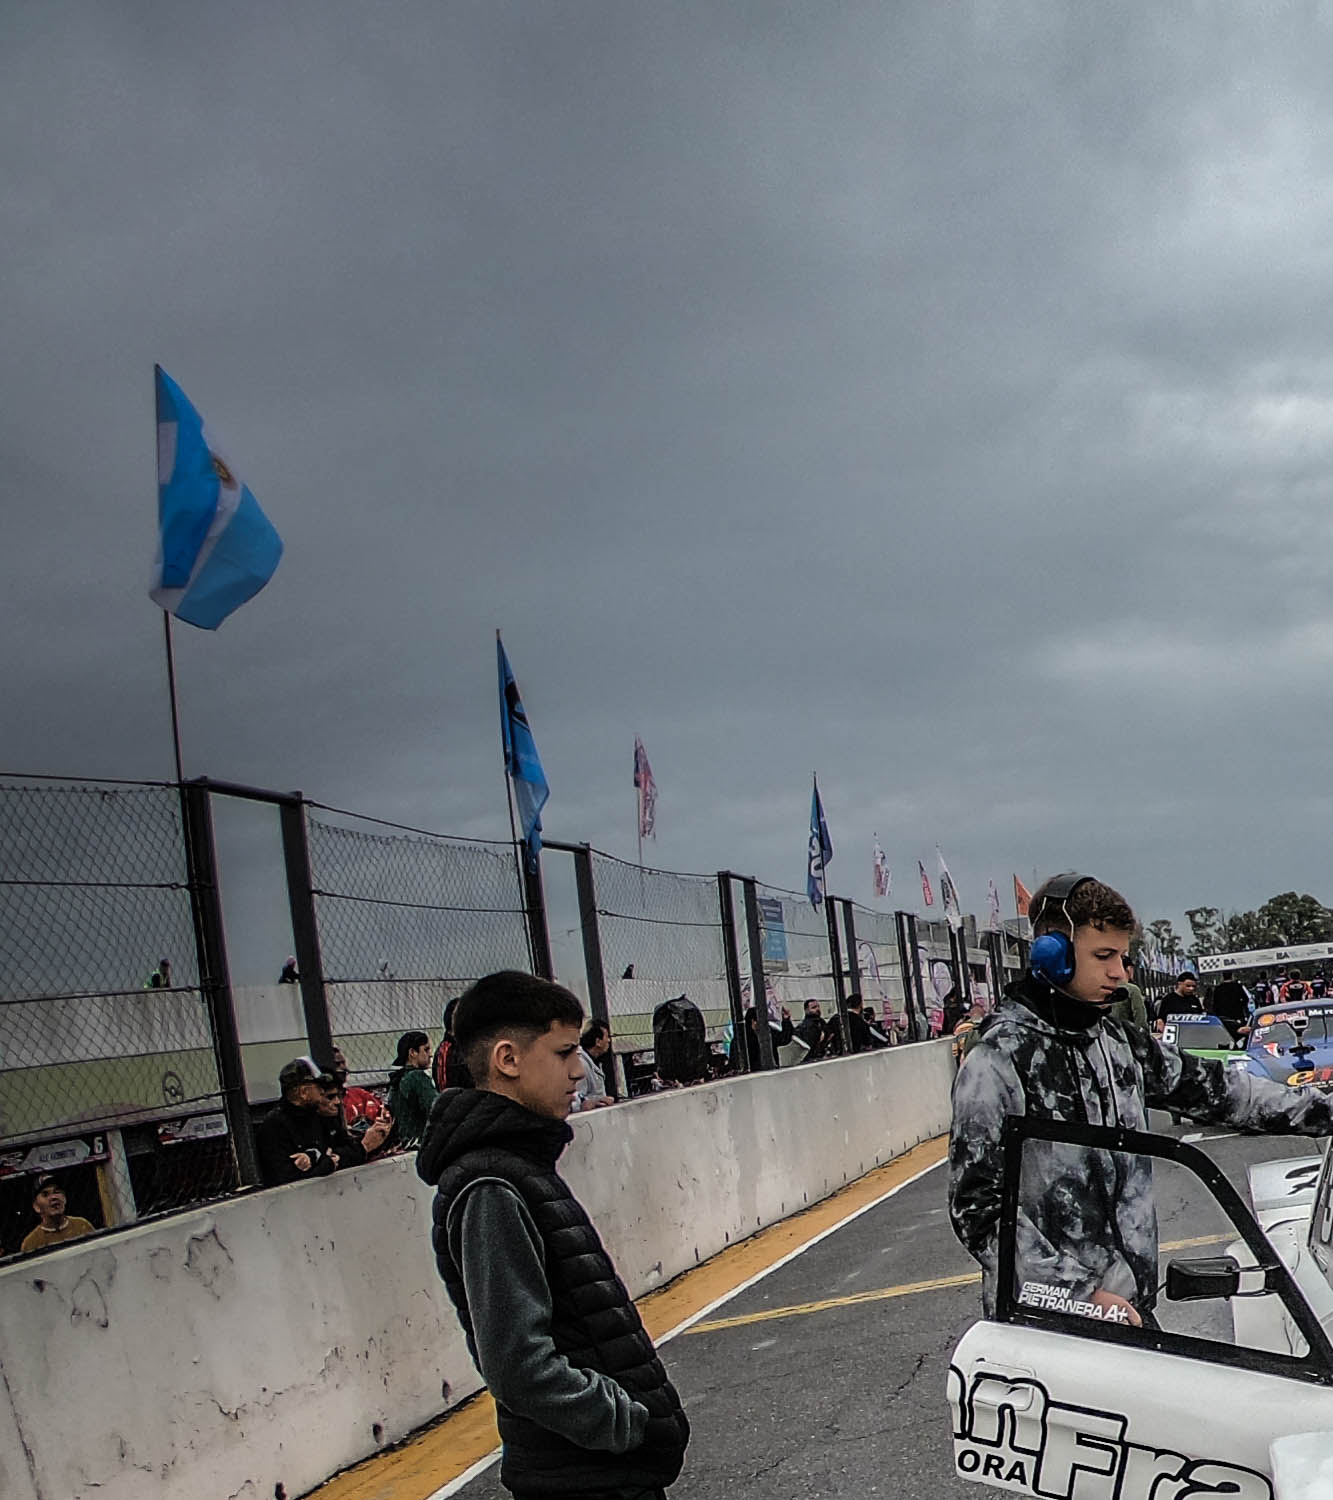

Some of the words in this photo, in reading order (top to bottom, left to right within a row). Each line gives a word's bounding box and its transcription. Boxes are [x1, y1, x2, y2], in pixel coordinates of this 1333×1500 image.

[1162, 1025, 1177, 1044] 6
[1022, 1281, 1071, 1299] GERMAN
[1017, 1291, 1104, 1321] PIETRANERA
[1103, 1304, 1128, 1322] A+
[958, 1449, 1027, 1486] ORA
